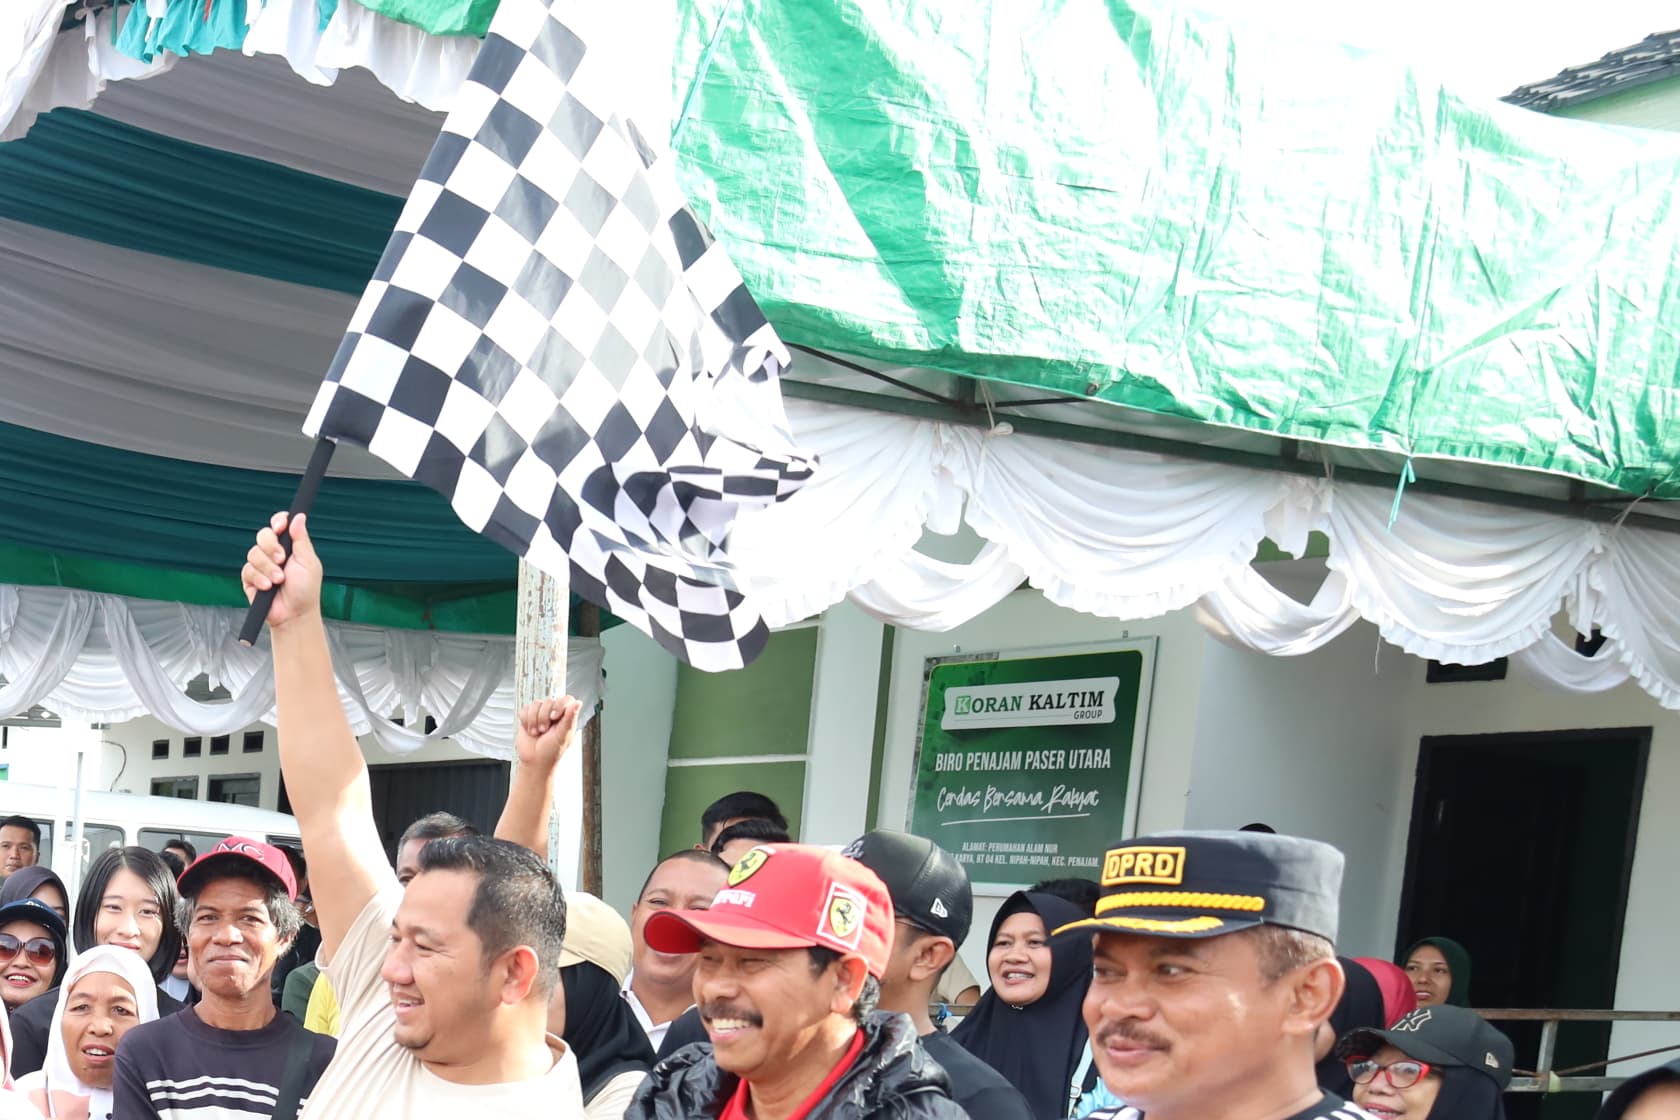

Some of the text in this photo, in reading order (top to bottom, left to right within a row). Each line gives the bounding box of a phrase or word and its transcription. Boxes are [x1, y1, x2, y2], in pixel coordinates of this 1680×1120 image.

[954, 690, 1105, 715] KORAN KALTIM
[1073, 709, 1103, 720] GROUP
[935, 749, 1111, 772] BIRO PENAJAM PASER UTARA
[937, 784, 1099, 813] Cerdas Bersama Rakyat
[1106, 852, 1174, 878] DPRD
